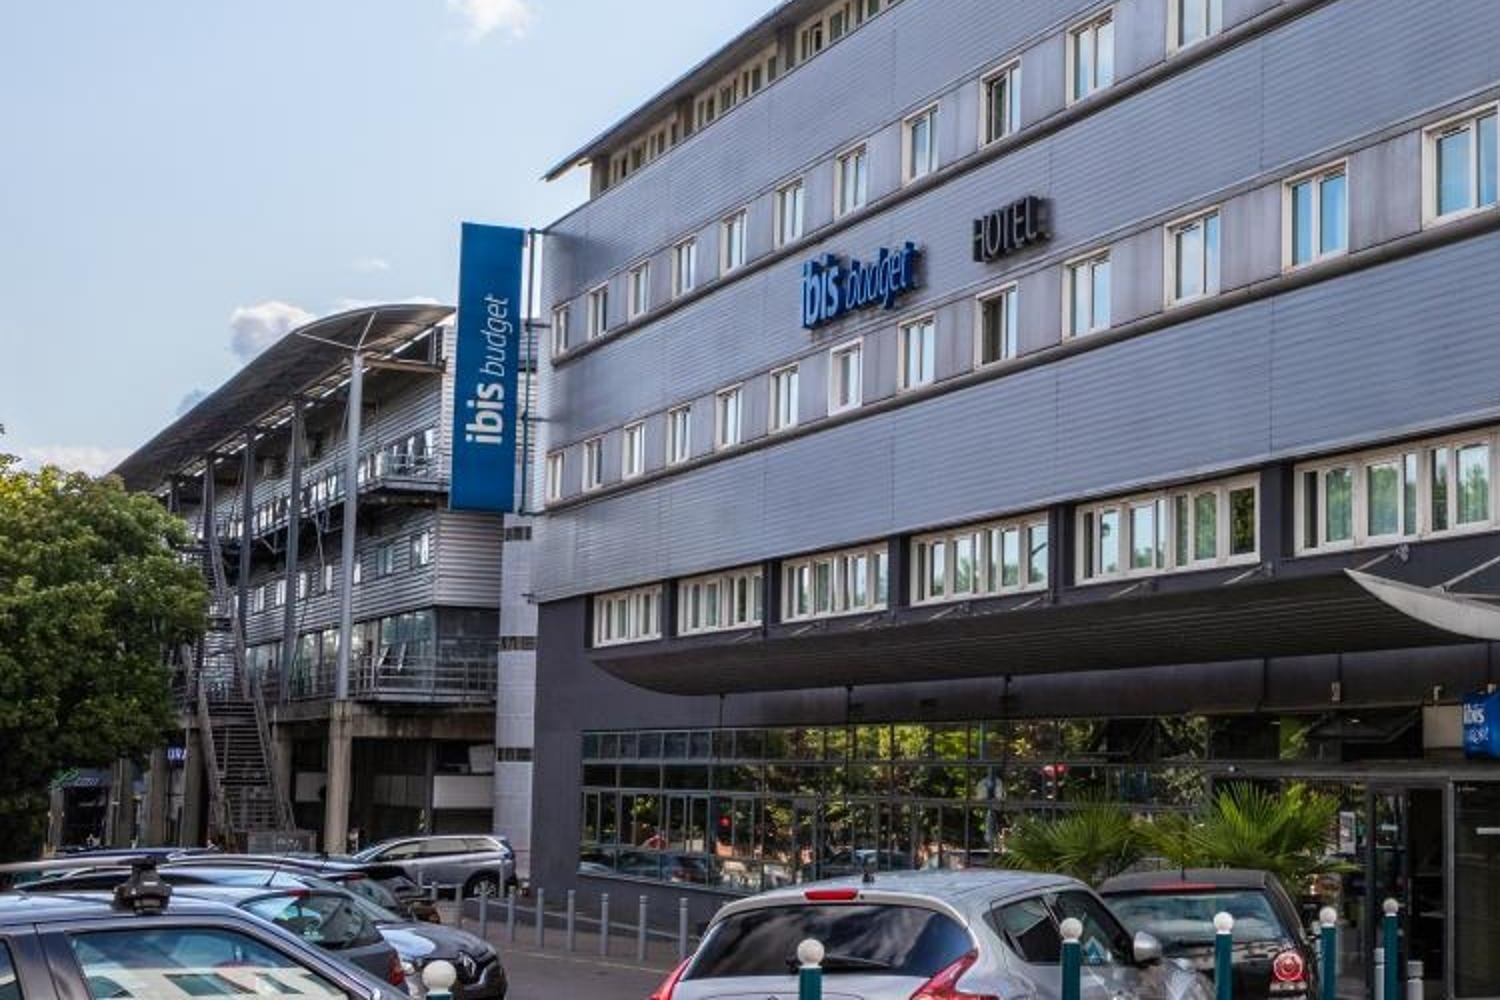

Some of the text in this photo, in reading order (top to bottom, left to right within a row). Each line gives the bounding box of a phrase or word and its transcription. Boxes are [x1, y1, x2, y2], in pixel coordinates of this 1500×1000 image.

[972, 195, 1038, 263] HOTEL
[800, 245, 910, 328] ibis budget
[465, 293, 514, 444] ibis budget
